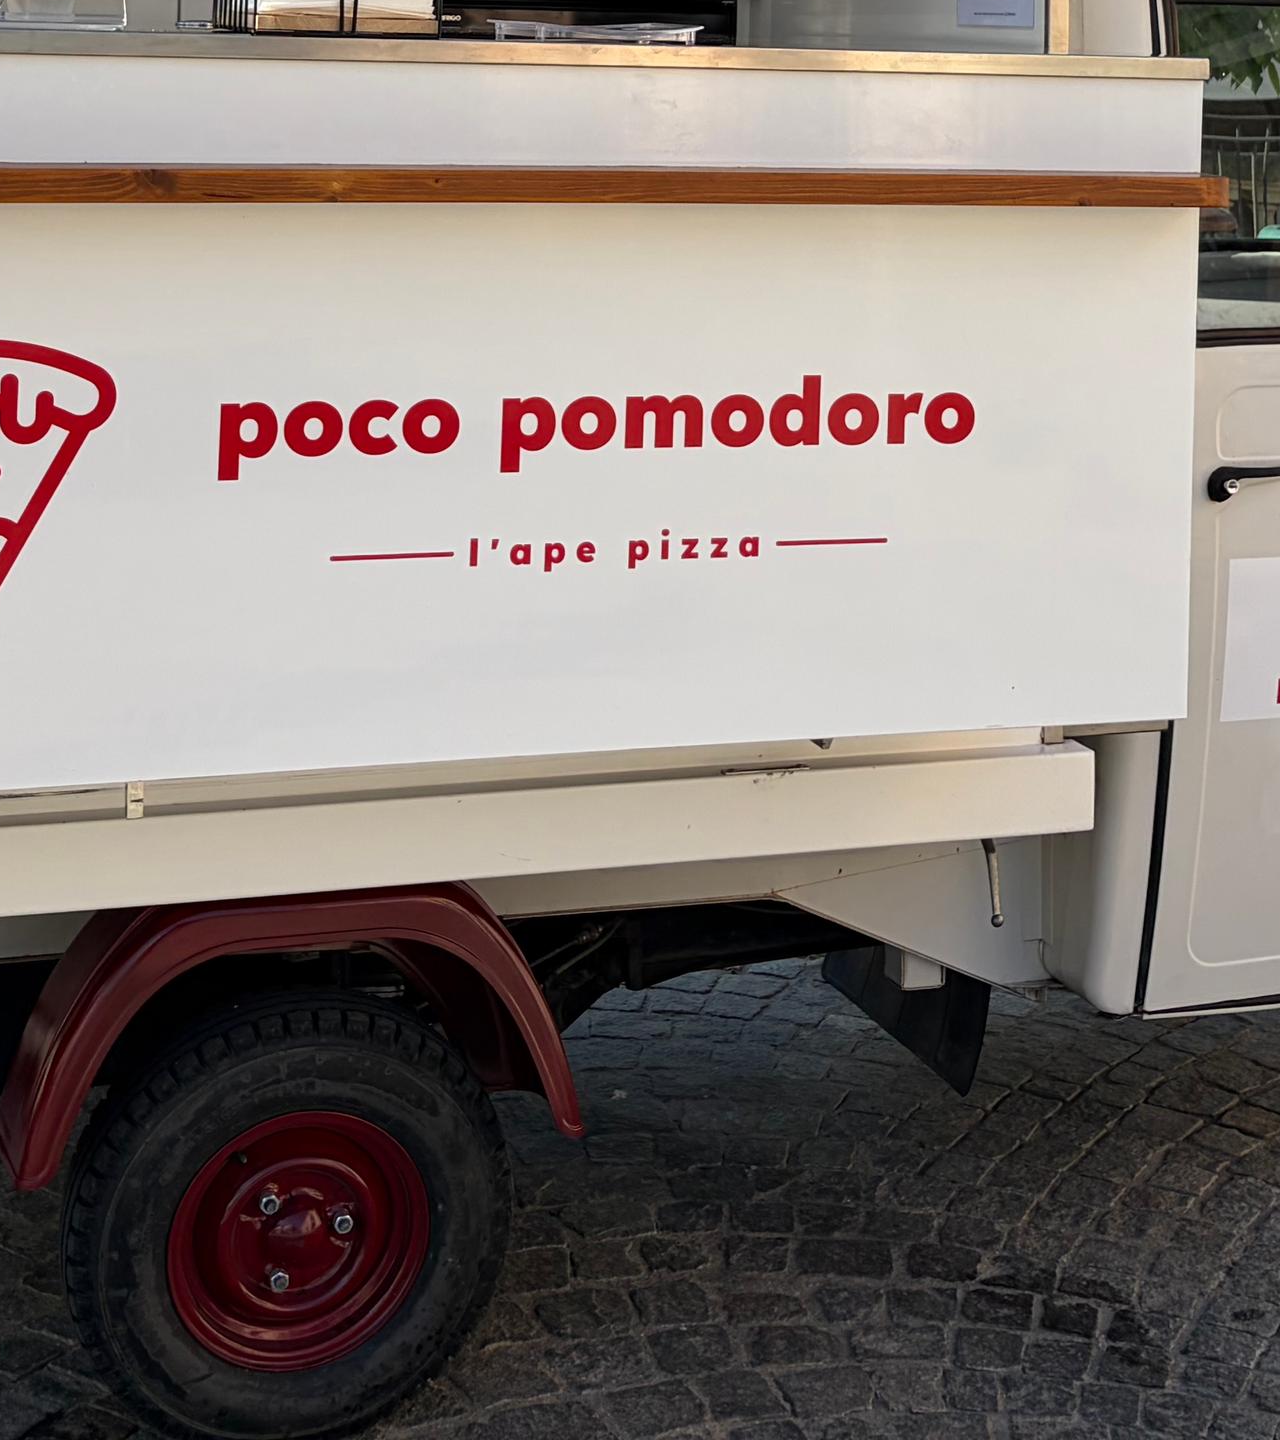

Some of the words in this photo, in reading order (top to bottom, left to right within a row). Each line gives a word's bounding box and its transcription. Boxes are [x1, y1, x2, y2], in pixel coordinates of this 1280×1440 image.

[218, 399, 461, 482] poco
[499, 374, 976, 474] pomodoro
[468, 538, 597, 573] l'ape
[627, 529, 761, 570] pizza
